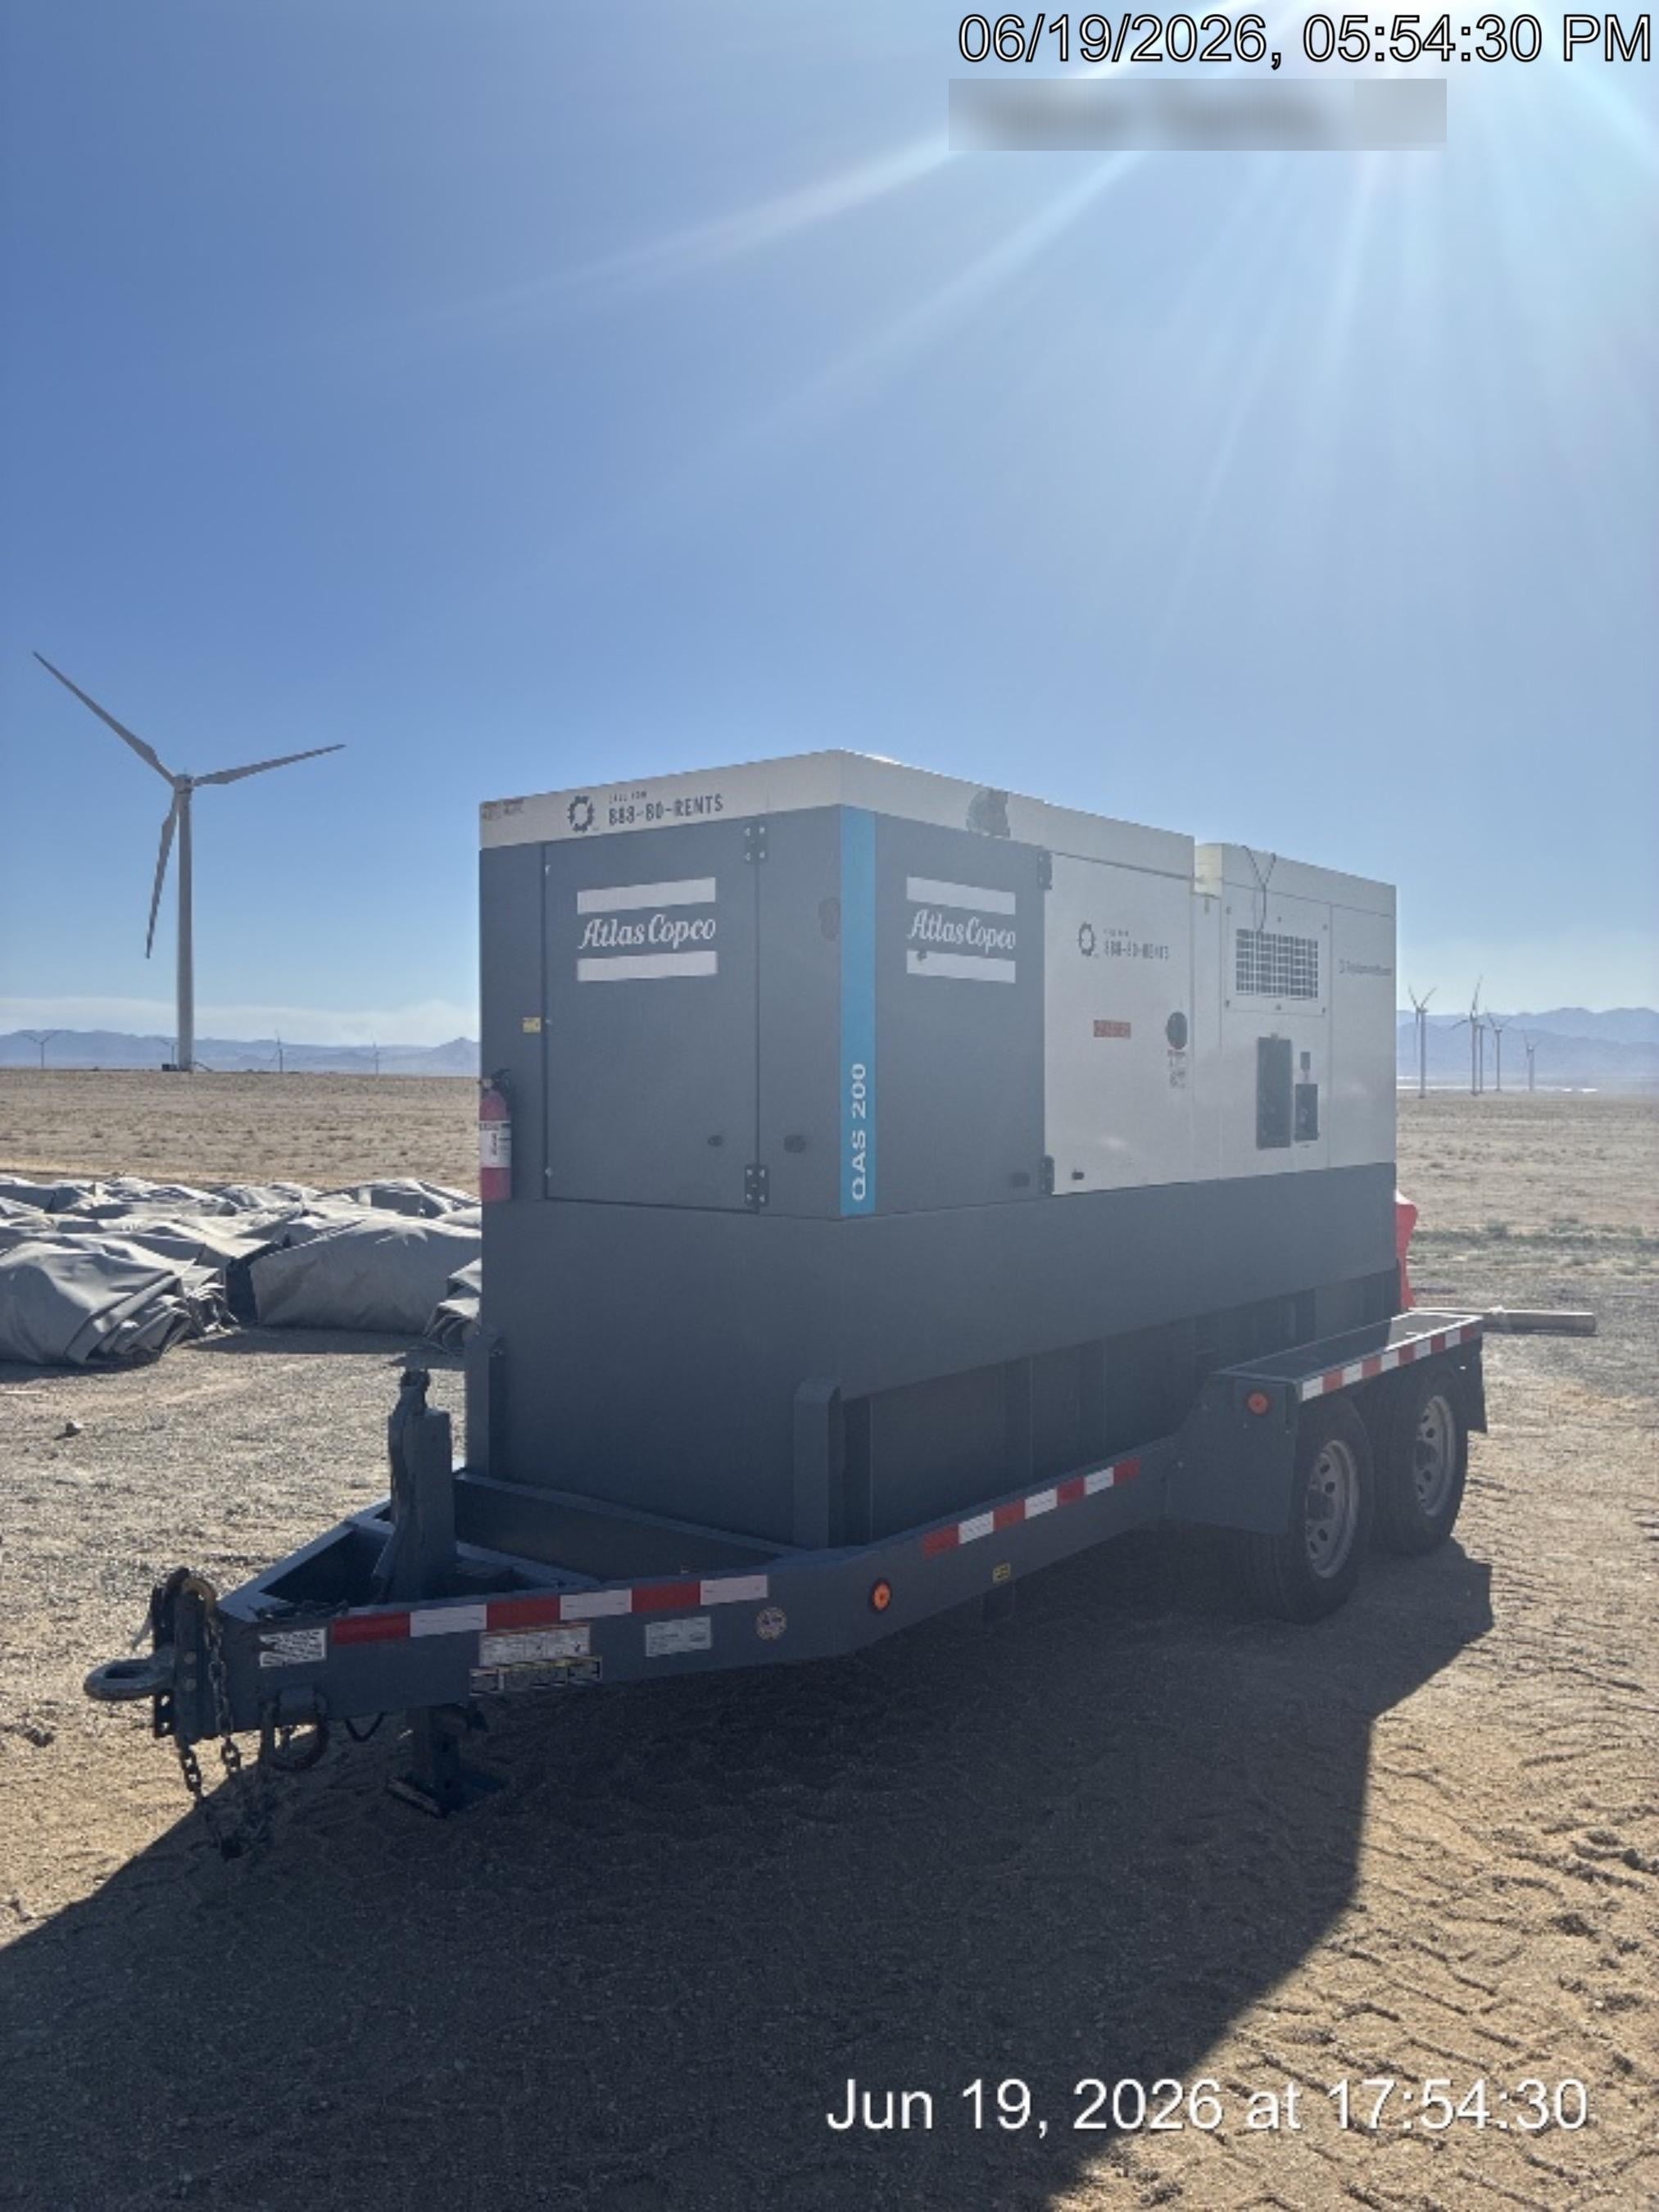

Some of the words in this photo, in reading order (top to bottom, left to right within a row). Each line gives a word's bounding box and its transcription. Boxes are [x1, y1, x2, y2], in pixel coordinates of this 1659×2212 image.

[578, 918, 645, 950] Atlas
[648, 913, 716, 950] Copco
[906, 909, 964, 945] Atlas
[965, 916, 1016, 954] Copco
[851, 1063, 867, 1119] 200
[851, 1130, 867, 1202] QAS
